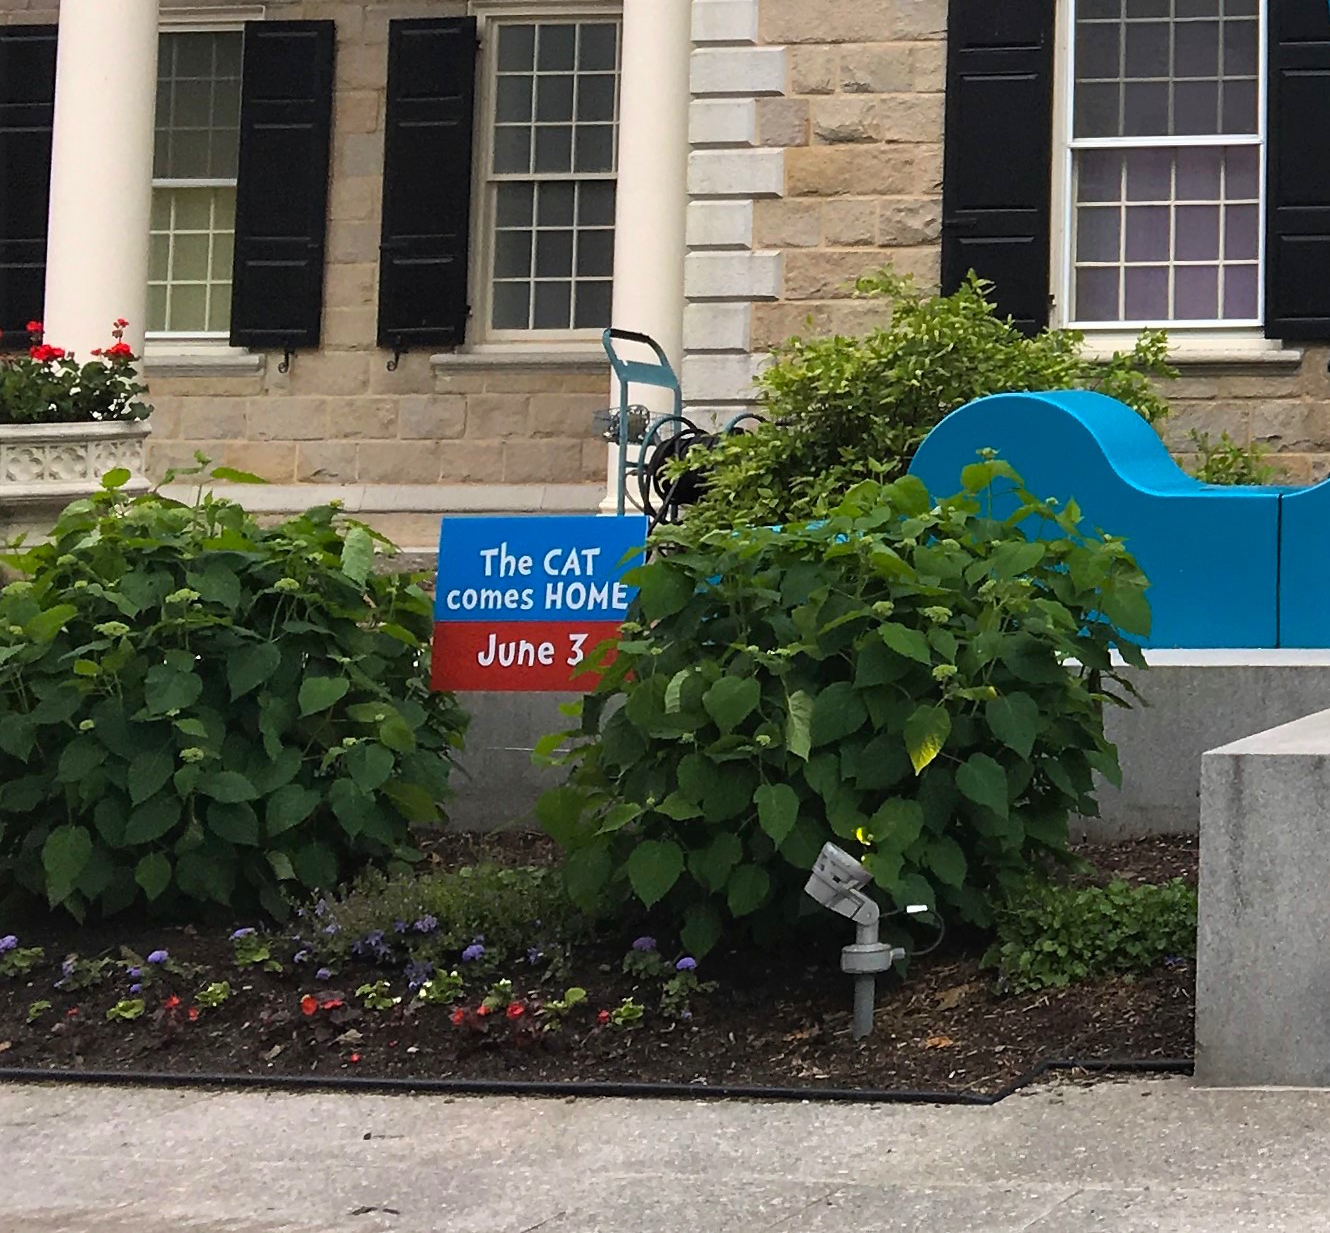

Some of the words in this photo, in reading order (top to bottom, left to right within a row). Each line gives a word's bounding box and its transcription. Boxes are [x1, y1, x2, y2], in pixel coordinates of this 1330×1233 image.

[480, 542, 533, 578] The
[543, 547, 601, 576] CAT
[446, 588, 534, 610] comes
[544, 581, 628, 610] HOME
[477, 633, 555, 667] June
[566, 633, 589, 666] 3
